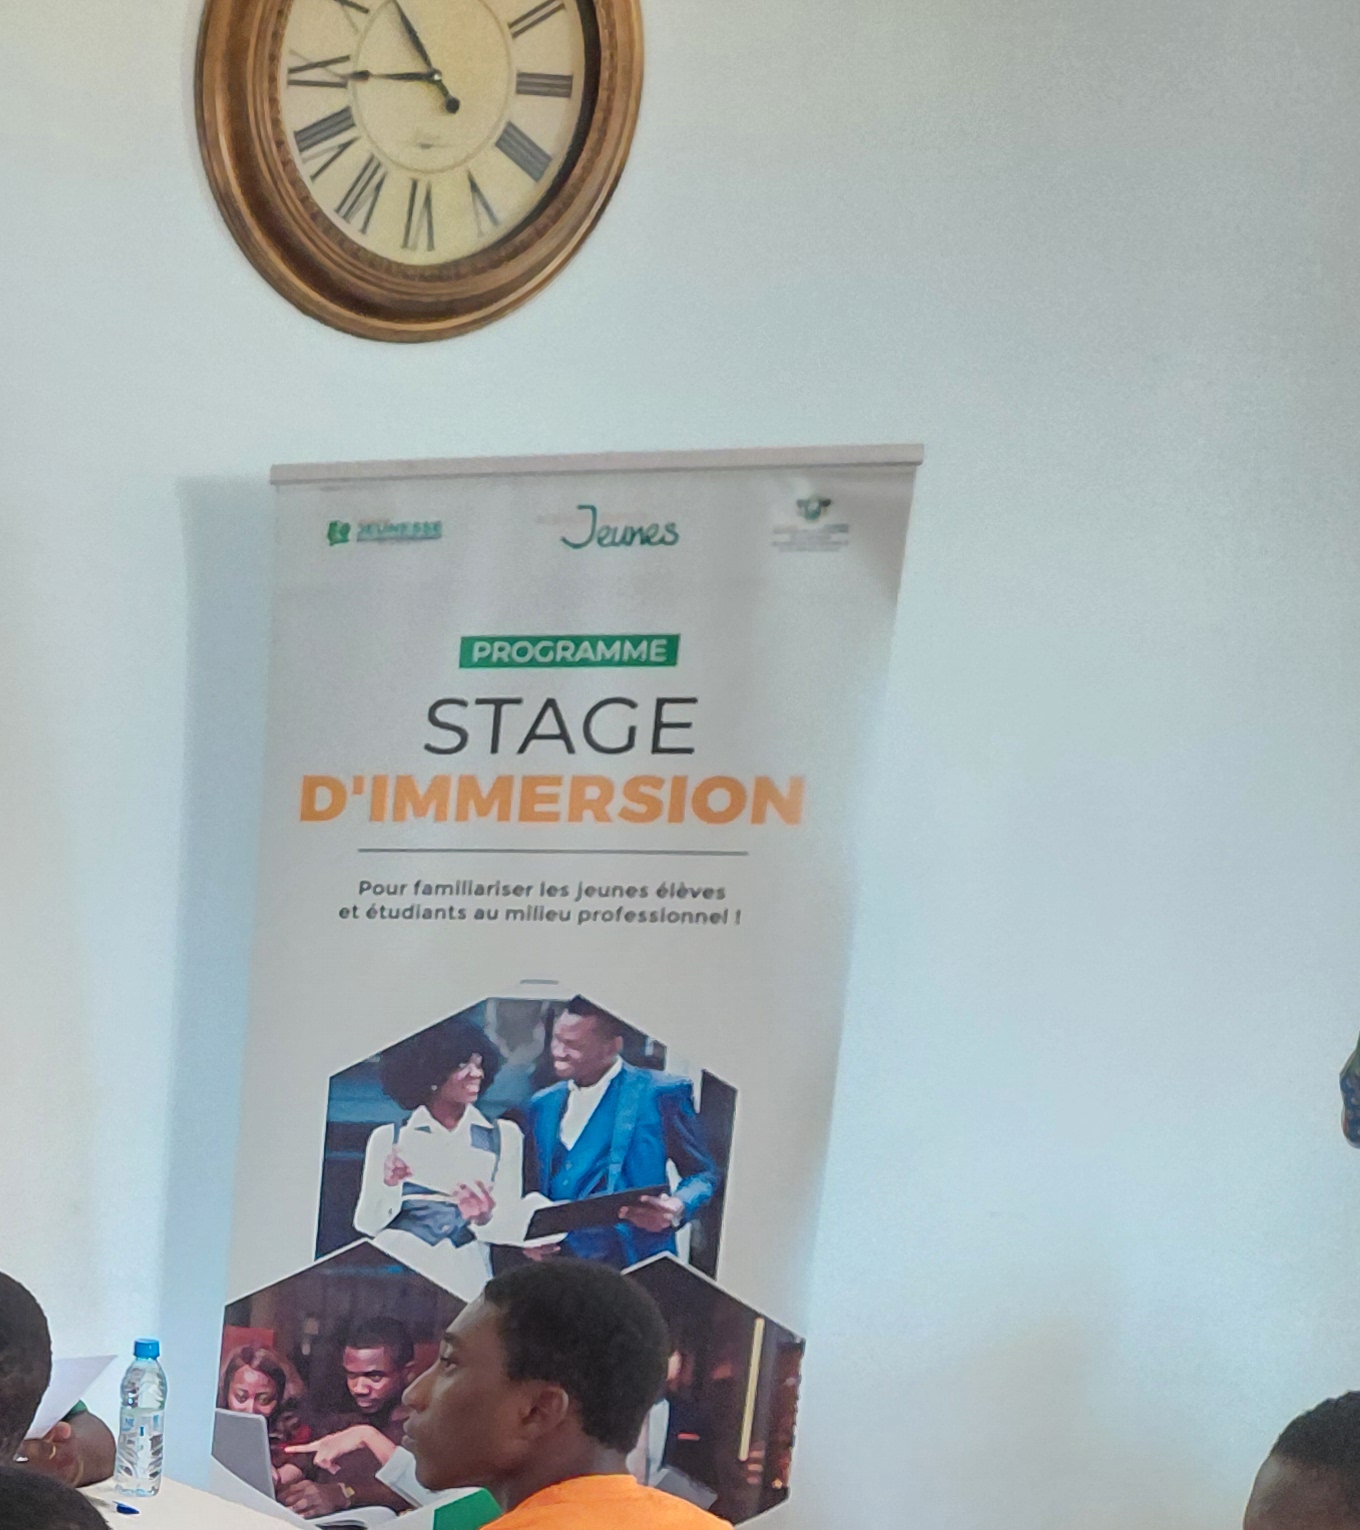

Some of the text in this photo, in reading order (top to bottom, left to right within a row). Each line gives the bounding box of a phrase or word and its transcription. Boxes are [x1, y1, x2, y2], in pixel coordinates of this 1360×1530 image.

[560, 504, 680, 549] Jeunes
[472, 639, 668, 664] PROGRAMME
[423, 696, 698, 755] STAGE
[299, 774, 805, 826] D'IMMERSION
[359, 879, 727, 902] Pour familiariser les jeunes élèves
[338, 904, 359, 919] et
[366, 902, 467, 920] étudiants
[474, 908, 499, 921] au
[505, 904, 571, 922] milieu
[577, 905, 728, 925] professionnel
